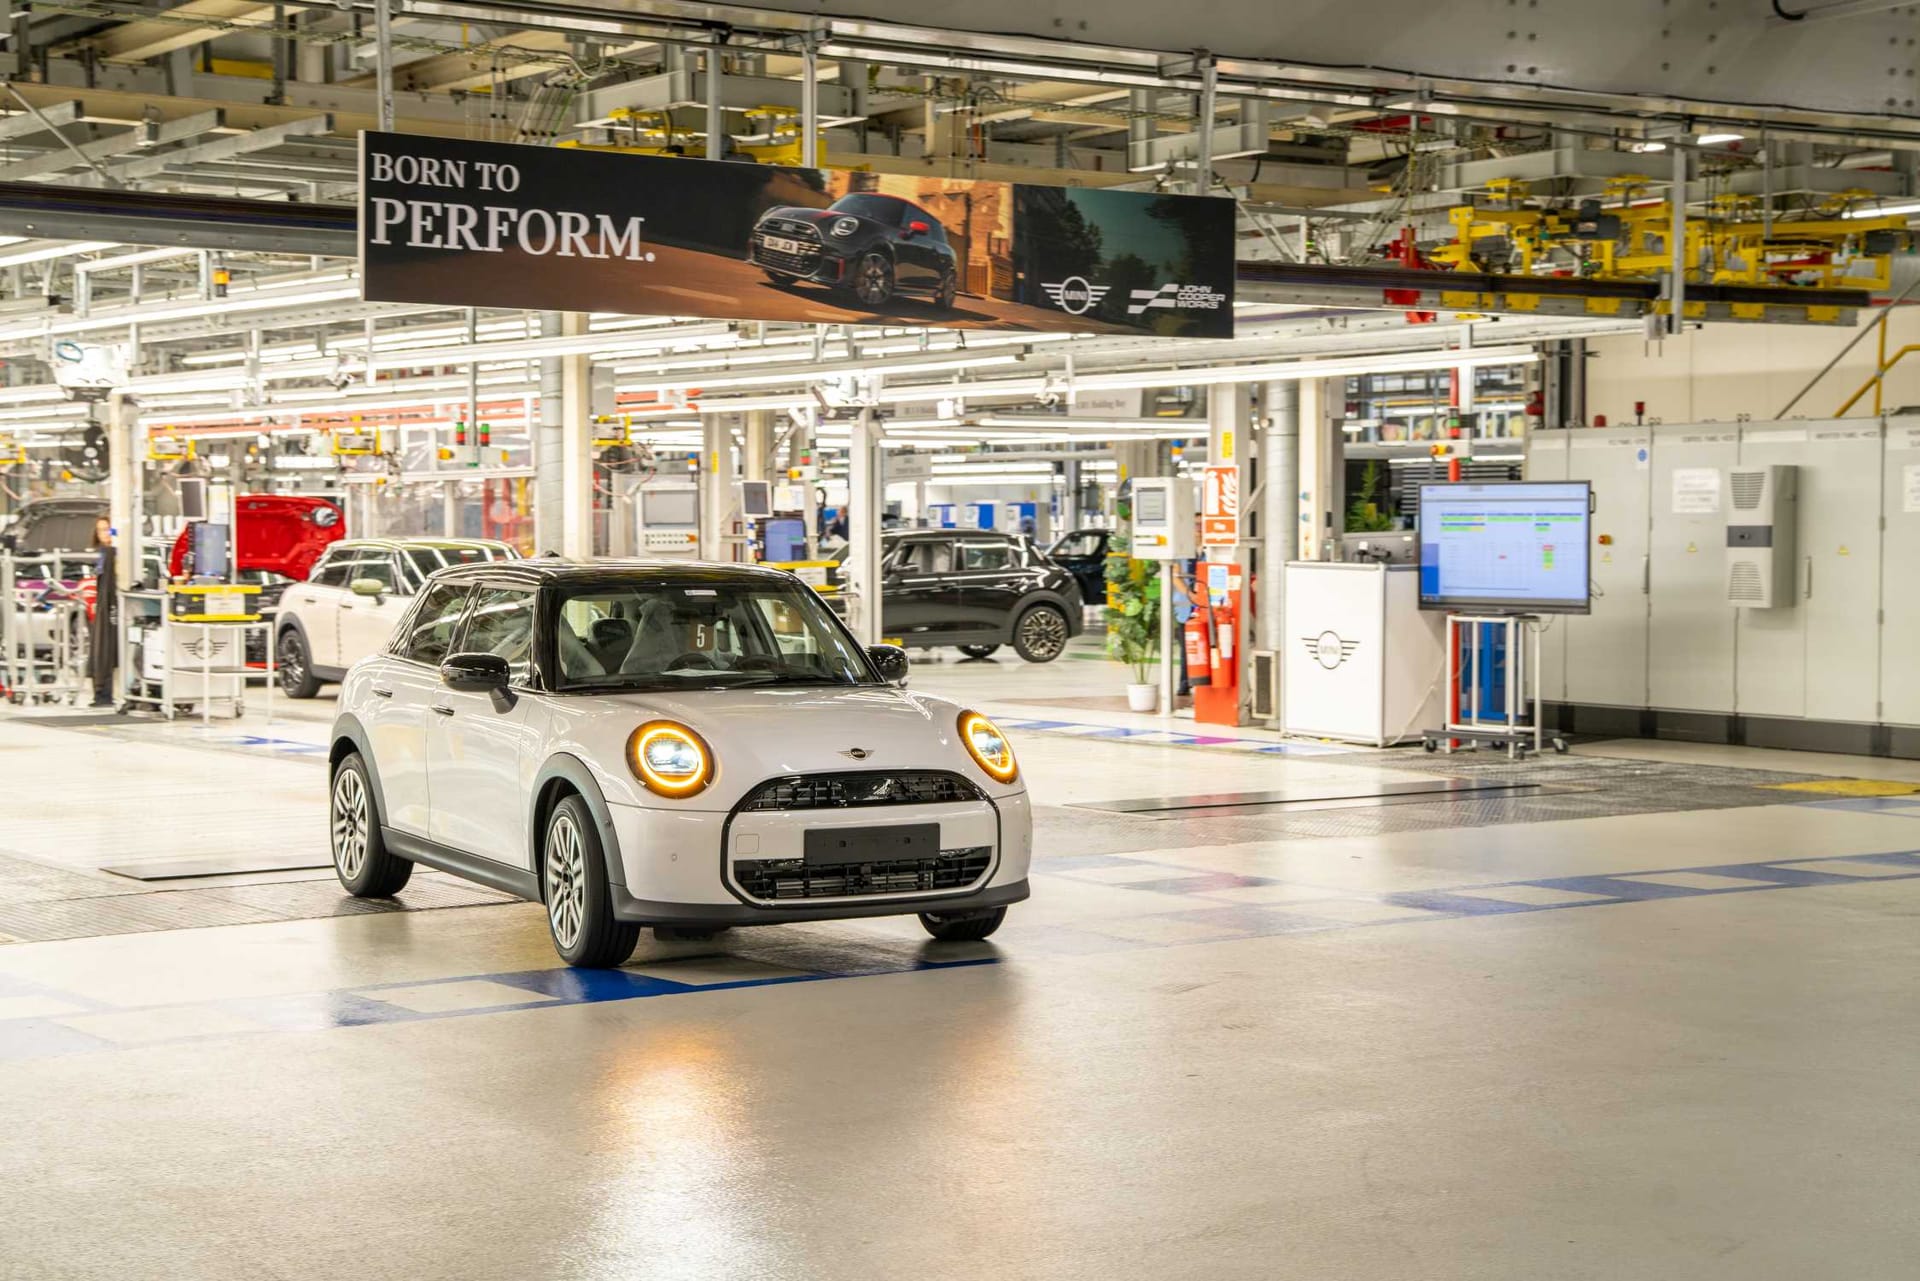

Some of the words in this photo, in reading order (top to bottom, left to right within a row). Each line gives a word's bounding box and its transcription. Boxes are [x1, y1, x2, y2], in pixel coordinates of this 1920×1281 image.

[370, 152, 467, 188] BORN
[474, 162, 521, 192] TO
[370, 197, 656, 262] PERFORM.
[1177, 292, 1226, 302] COOPER
[1178, 284, 1212, 294] JOHN
[1177, 300, 1219, 309] WORKS
[696, 623, 706, 648] 5
